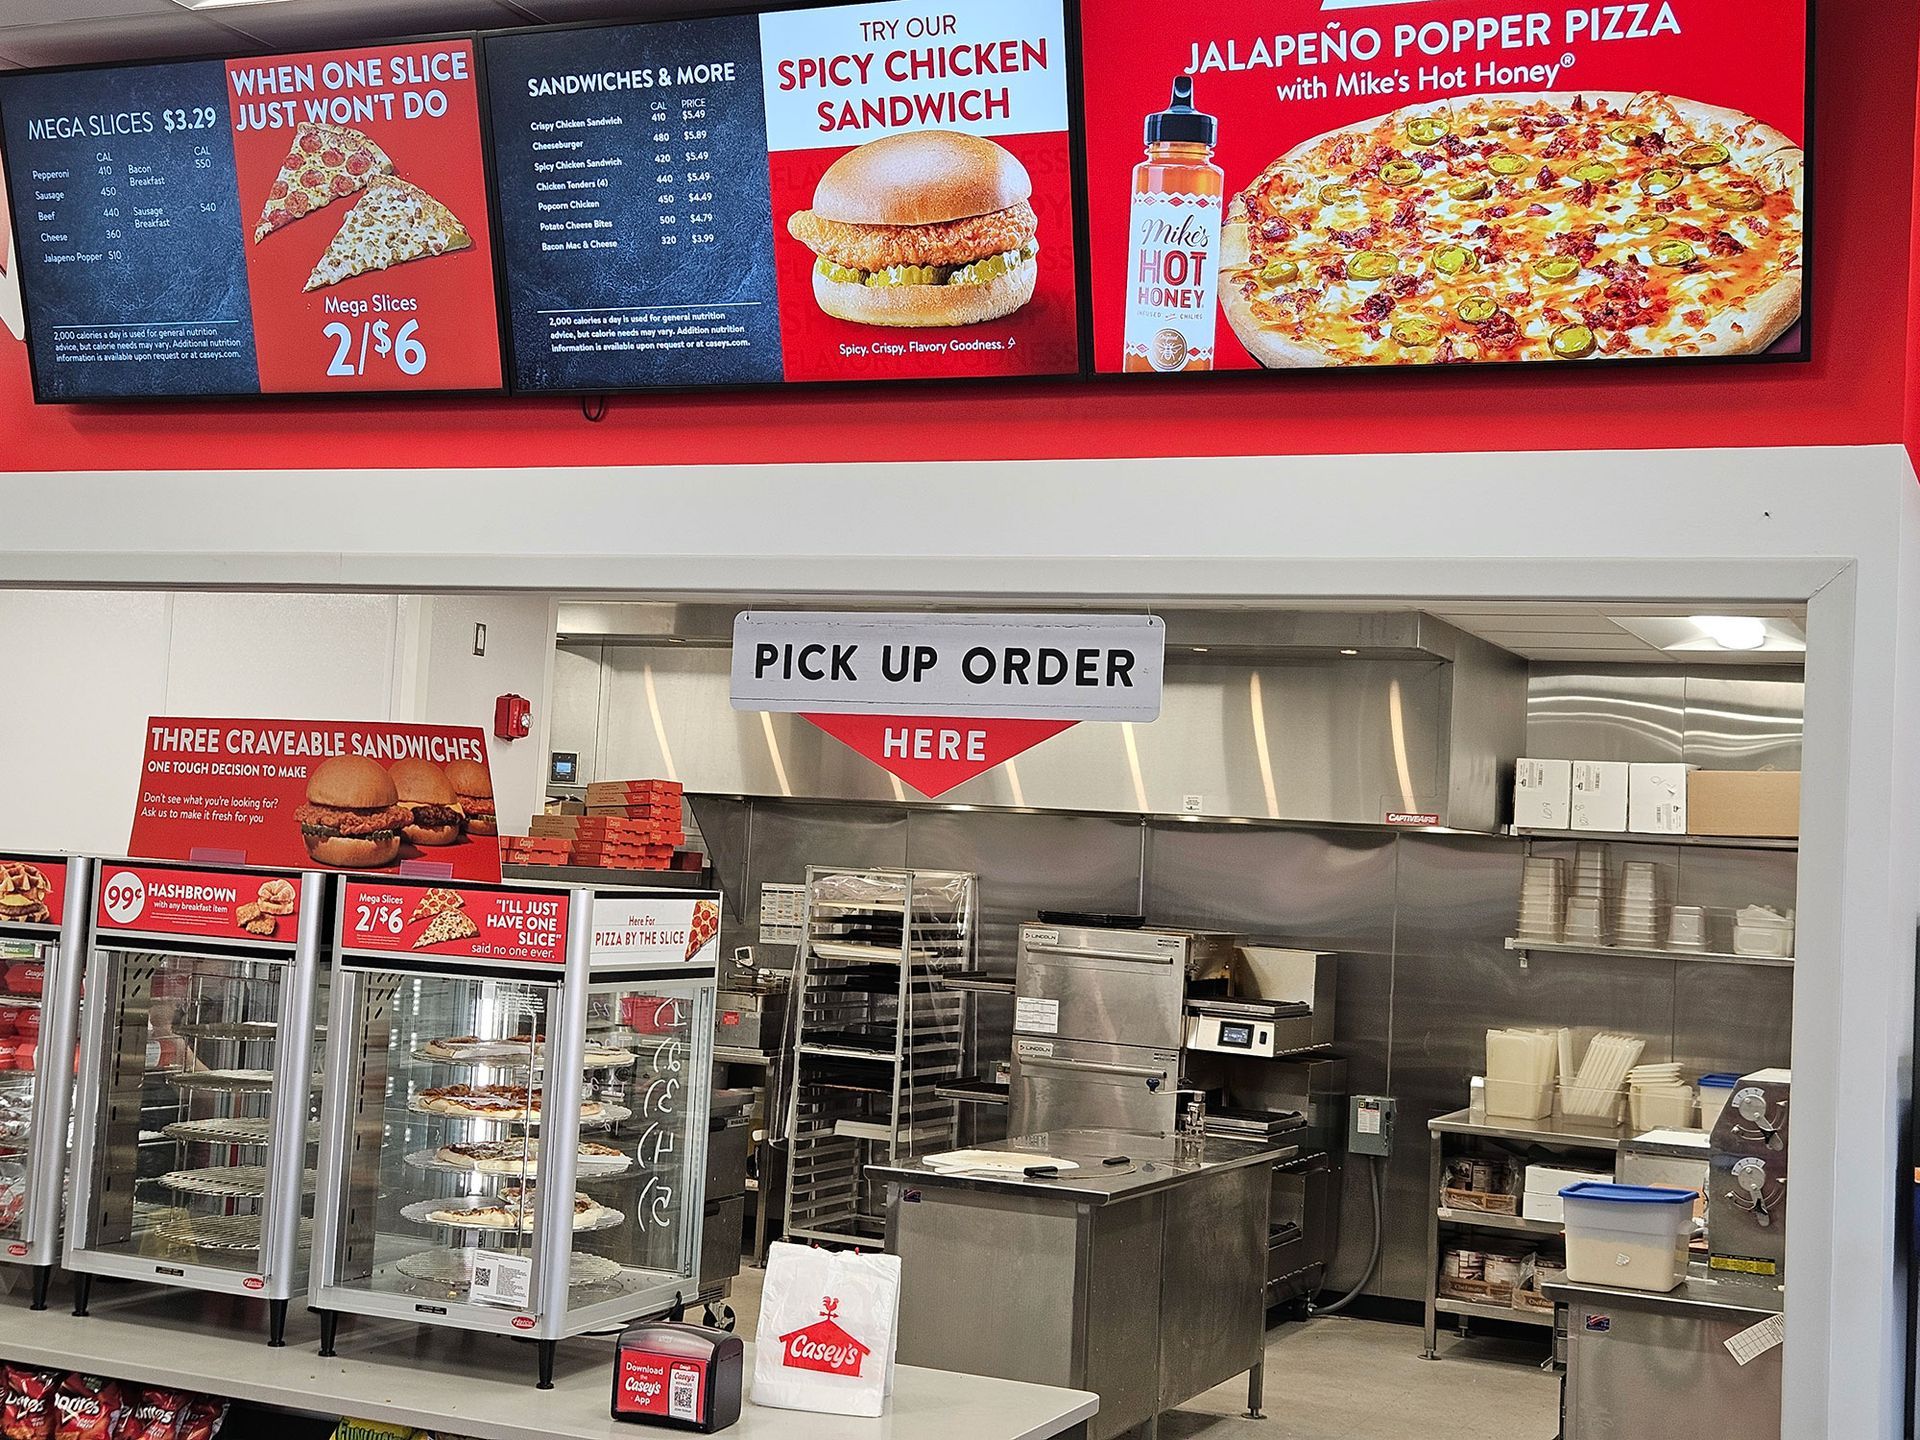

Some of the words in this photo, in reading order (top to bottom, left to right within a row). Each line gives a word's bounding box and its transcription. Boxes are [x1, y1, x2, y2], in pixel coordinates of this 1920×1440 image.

[860, 19, 900, 42] TRY
[906, 14, 957, 38] OUR
[1183, 22, 1382, 76] JALAPEÑO
[1394, 14, 1551, 58] POPPER
[1564, 0, 1682, 44] PIZZA
[777, 53, 874, 91] SPICY
[884, 38, 1048, 82] CHICKEN
[231, 64, 315, 97] WHEN
[322, 59, 383, 90] ONE
[391, 52, 469, 85] SLICE
[527, 69, 654, 97] SANDWICHES
[659, 68, 672, 86] &
[677, 62, 736, 85] MORE
[1276, 73, 1328, 102] with
[1335, 67, 1411, 98] Mike's
[1417, 64, 1467, 92] Hot
[236, 101, 297, 131] JUST
[304, 93, 395, 124] WON'T
[403, 89, 448, 119] DO
[650, 101, 667, 111] CAL
[681, 98, 706, 108] PRICE
[817, 87, 1010, 132] SANDWICH
[28, 116, 86, 140] MEGA
[89, 111, 154, 137] SLICES
[162, 107, 217, 134] $3.29
[530, 121, 554, 132] Crispy
[555, 119, 585, 130] Chicken
[586, 117, 622, 128] Sandwich
[652, 112, 666, 121] 410
[682, 110, 706, 121] $5.49
[532, 140, 583, 151] Cheeseburger
[653, 133, 669, 142] 480
[683, 130, 707, 141] $5.89
[96, 153, 113, 163] CAL
[194, 146, 211, 156] CAL
[534, 162, 554, 173] Spicy
[555, 160, 586, 170] Chicken
[586, 157, 622, 168] Sandwich
[654, 154, 671, 163] 420
[685, 151, 709, 162] $5.49
[32, 169, 70, 182] Pepperoni
[98, 166, 112, 176] 410
[128, 165, 152, 175] Bacon
[195, 159, 211, 169] 550
[129, 176, 165, 187] Breakfast
[536, 181, 566, 191] Chicken
[566, 180, 596, 190] Tenders
[597, 178, 609, 189] (4)
[656, 175, 673, 184] 440
[687, 172, 711, 183] $5.49
[35, 190, 65, 202] Sausage
[100, 187, 117, 197] 450
[538, 201, 569, 212] Popcorn
[569, 200, 600, 210] Chicken
[658, 195, 674, 204] 450
[688, 192, 712, 203] $4.49
[38, 211, 56, 222] Beef
[103, 207, 120, 217] 440
[133, 206, 164, 217] Sausage
[200, 203, 217, 212] 540
[134, 218, 170, 229] Breakfast
[540, 221, 565, 232] Potato
[566, 220, 593, 231] Cheese
[593, 219, 613, 229] Bites
[659, 215, 676, 225] 500
[690, 213, 713, 224] $4.79
[1141, 214, 1210, 248] Mike's
[40, 232, 68, 243] Cheese
[106, 229, 122, 239] 360
[542, 241, 564, 251] Bacon
[565, 241, 582, 251] Mac
[582, 240, 590, 250] &
[590, 239, 617, 250] Cheese
[661, 236, 677, 245] 320
[692, 233, 714, 244] $3.99
[43, 252, 76, 264] Jalapeno
[76, 251, 103, 263] Popper
[108, 250, 122, 260] 510
[1138, 249, 1207, 287] HOT
[324, 296, 368, 317] Mega
[372, 294, 417, 312] Slices
[1138, 287, 1204, 309] HONEY
[322, 318, 427, 376] 2/$6
[839, 342, 869, 357] Spicy.
[871, 341, 906, 356] Crispy.
[909, 340, 947, 355] Flavory
[949, 339, 1005, 351] Goodness.
[754, 642, 859, 682] PICK
[881, 644, 938, 683] UP
[961, 646, 1136, 688] ORDER
[152, 727, 220, 753] THREE
[226, 729, 346, 757] CRAVEABLE
[350, 732, 483, 764] SANDWICHES
[883, 727, 987, 761] HERE
[147, 761, 171, 774] ONE
[172, 762, 210, 776] TOUGH
[211, 763, 260, 777] DECISION
[262, 764, 276, 777] TO
[278, 765, 307, 779] MAKE
[143, 791, 166, 805] Don't
[166, 796, 181, 807] see
[183, 794, 203, 807] what
[204, 796, 230, 810] you're
[231, 796, 261, 811] looking
[262, 797, 279, 809] for?
[141, 807, 157, 818] Ask
[158, 810, 168, 819] us
[169, 809, 178, 819] to
[180, 808, 202, 821] make
[204, 809, 211, 820] it
[212, 810, 233, 822] fresh
[234, 811, 247, 822] for
[249, 813, 264, 825] you
[148, 882, 236, 902] HASHBROWN
[359, 893, 380, 905] Mega
[381, 894, 403, 905] Slices
[168, 902, 180, 911] any
[181, 902, 212, 912] breakfast
[212, 904, 228, 913] item
[524, 901, 558, 917] JUST
[355, 905, 404, 934] 2/$6
[487, 915, 526, 930] HAVE
[528, 916, 557, 931] ONE
[628, 915, 644, 926] Here
[645, 915, 656, 926] For
[518, 931, 562, 948] SLICE"
[595, 932, 623, 947] PIZZA
[625, 932, 637, 946] BY
[638, 931, 658, 945] THE
[660, 930, 684, 945] SLICE
[471, 943, 491, 955] said
[493, 946, 506, 956] no
[508, 947, 527, 957] one
[529, 949, 555, 959] ever.
[790, 1335, 859, 1369] Casey's
[625, 1362, 664, 1375] Download
[625, 1377, 661, 1396] Casey's
[634, 1395, 651, 1406] App
